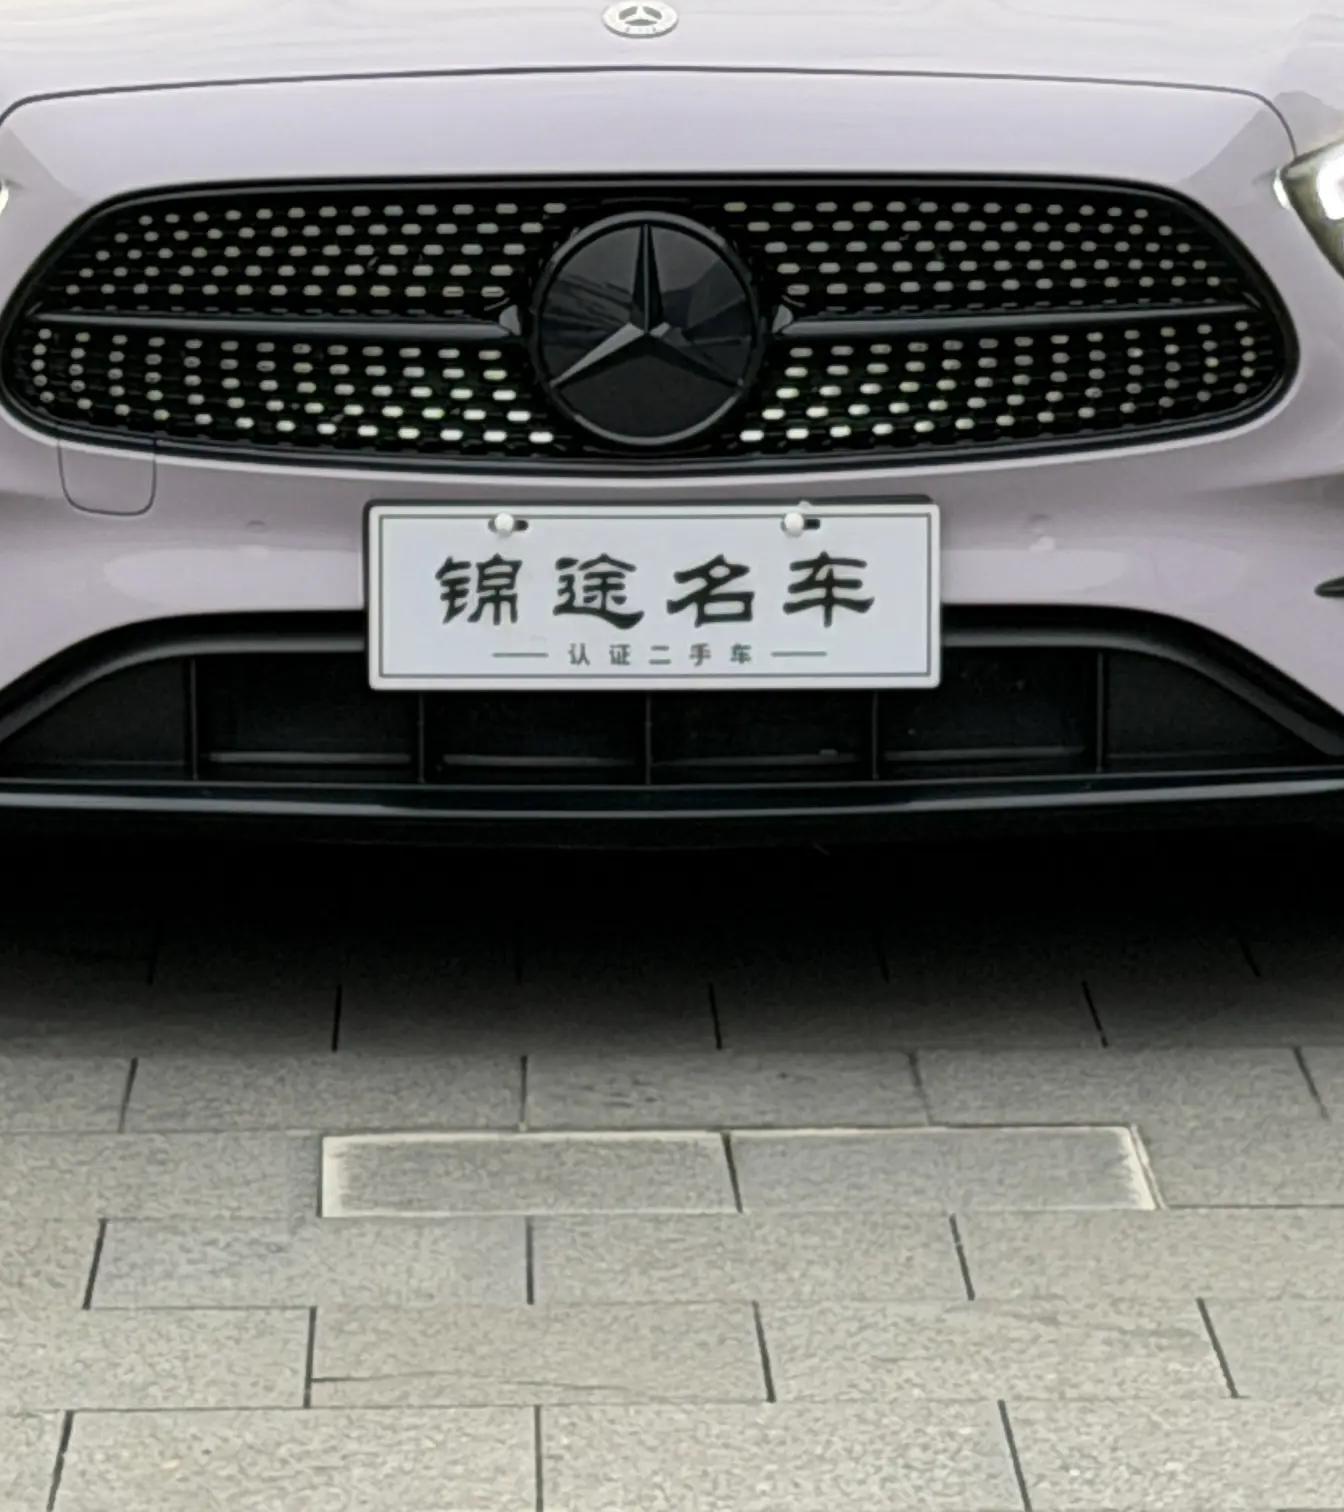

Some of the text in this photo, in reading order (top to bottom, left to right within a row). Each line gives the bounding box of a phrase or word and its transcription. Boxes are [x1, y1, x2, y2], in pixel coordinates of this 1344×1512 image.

[435, 551, 875, 629] 锦途名车
[567, 643, 753, 667] 认证二手车
